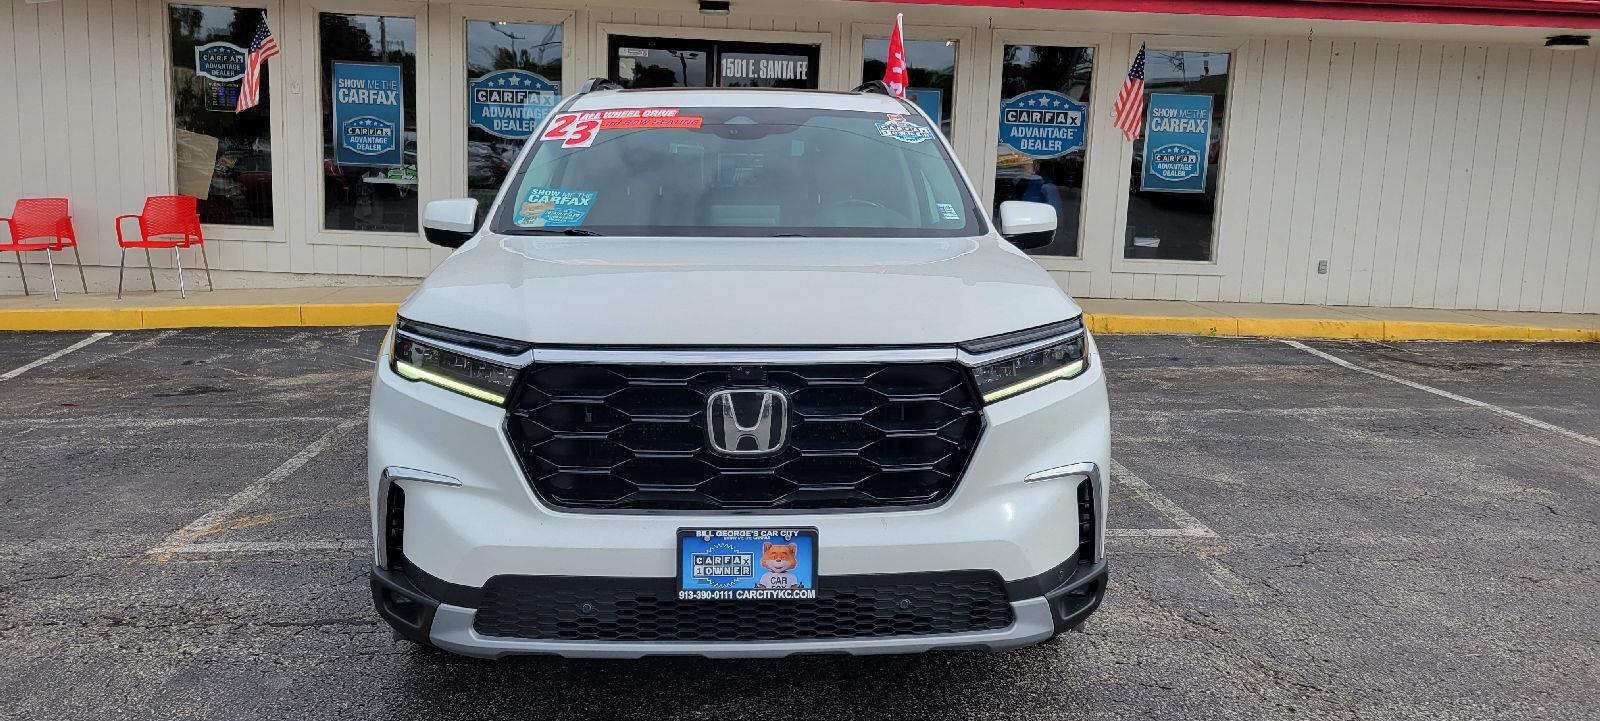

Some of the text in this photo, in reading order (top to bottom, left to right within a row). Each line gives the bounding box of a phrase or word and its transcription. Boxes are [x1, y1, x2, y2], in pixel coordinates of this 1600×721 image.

[203, 55, 244, 63] CARFAX
[206, 63, 240, 71] ADVANTAGE
[721, 58, 808, 80] 1501 E. SANTA FE
[338, 79, 397, 90] SHOW ME THE
[338, 88, 397, 106] CARFAX
[477, 90, 552, 106] CARFAX
[482, 106, 548, 120] ADVANTAGE
[580, 108, 678, 121] ALL WHEEL DRIVE
[1007, 111, 1079, 126] CARFAX
[1152, 108, 1207, 119] SHOW ME THE
[493, 119, 536, 132] DEALER
[1151, 117, 1205, 133] CARFAX
[348, 128, 391, 136] CARFAX
[1010, 126, 1074, 139] ADVANTAGE
[350, 136, 388, 144] ADVANTAGE
[1020, 138, 1062, 151] DEALER
[356, 143, 381, 151] DEALER
[1157, 163, 1192, 171] ADVANTAGE
[531, 188, 560, 196] SHOW
[528, 194, 590, 206] CARFAX
[695, 556, 751, 565] CARFAX
[770, 576, 788, 585] CAR
[679, 589, 816, 599] 913-390-0111 CARCITYKC.COM
